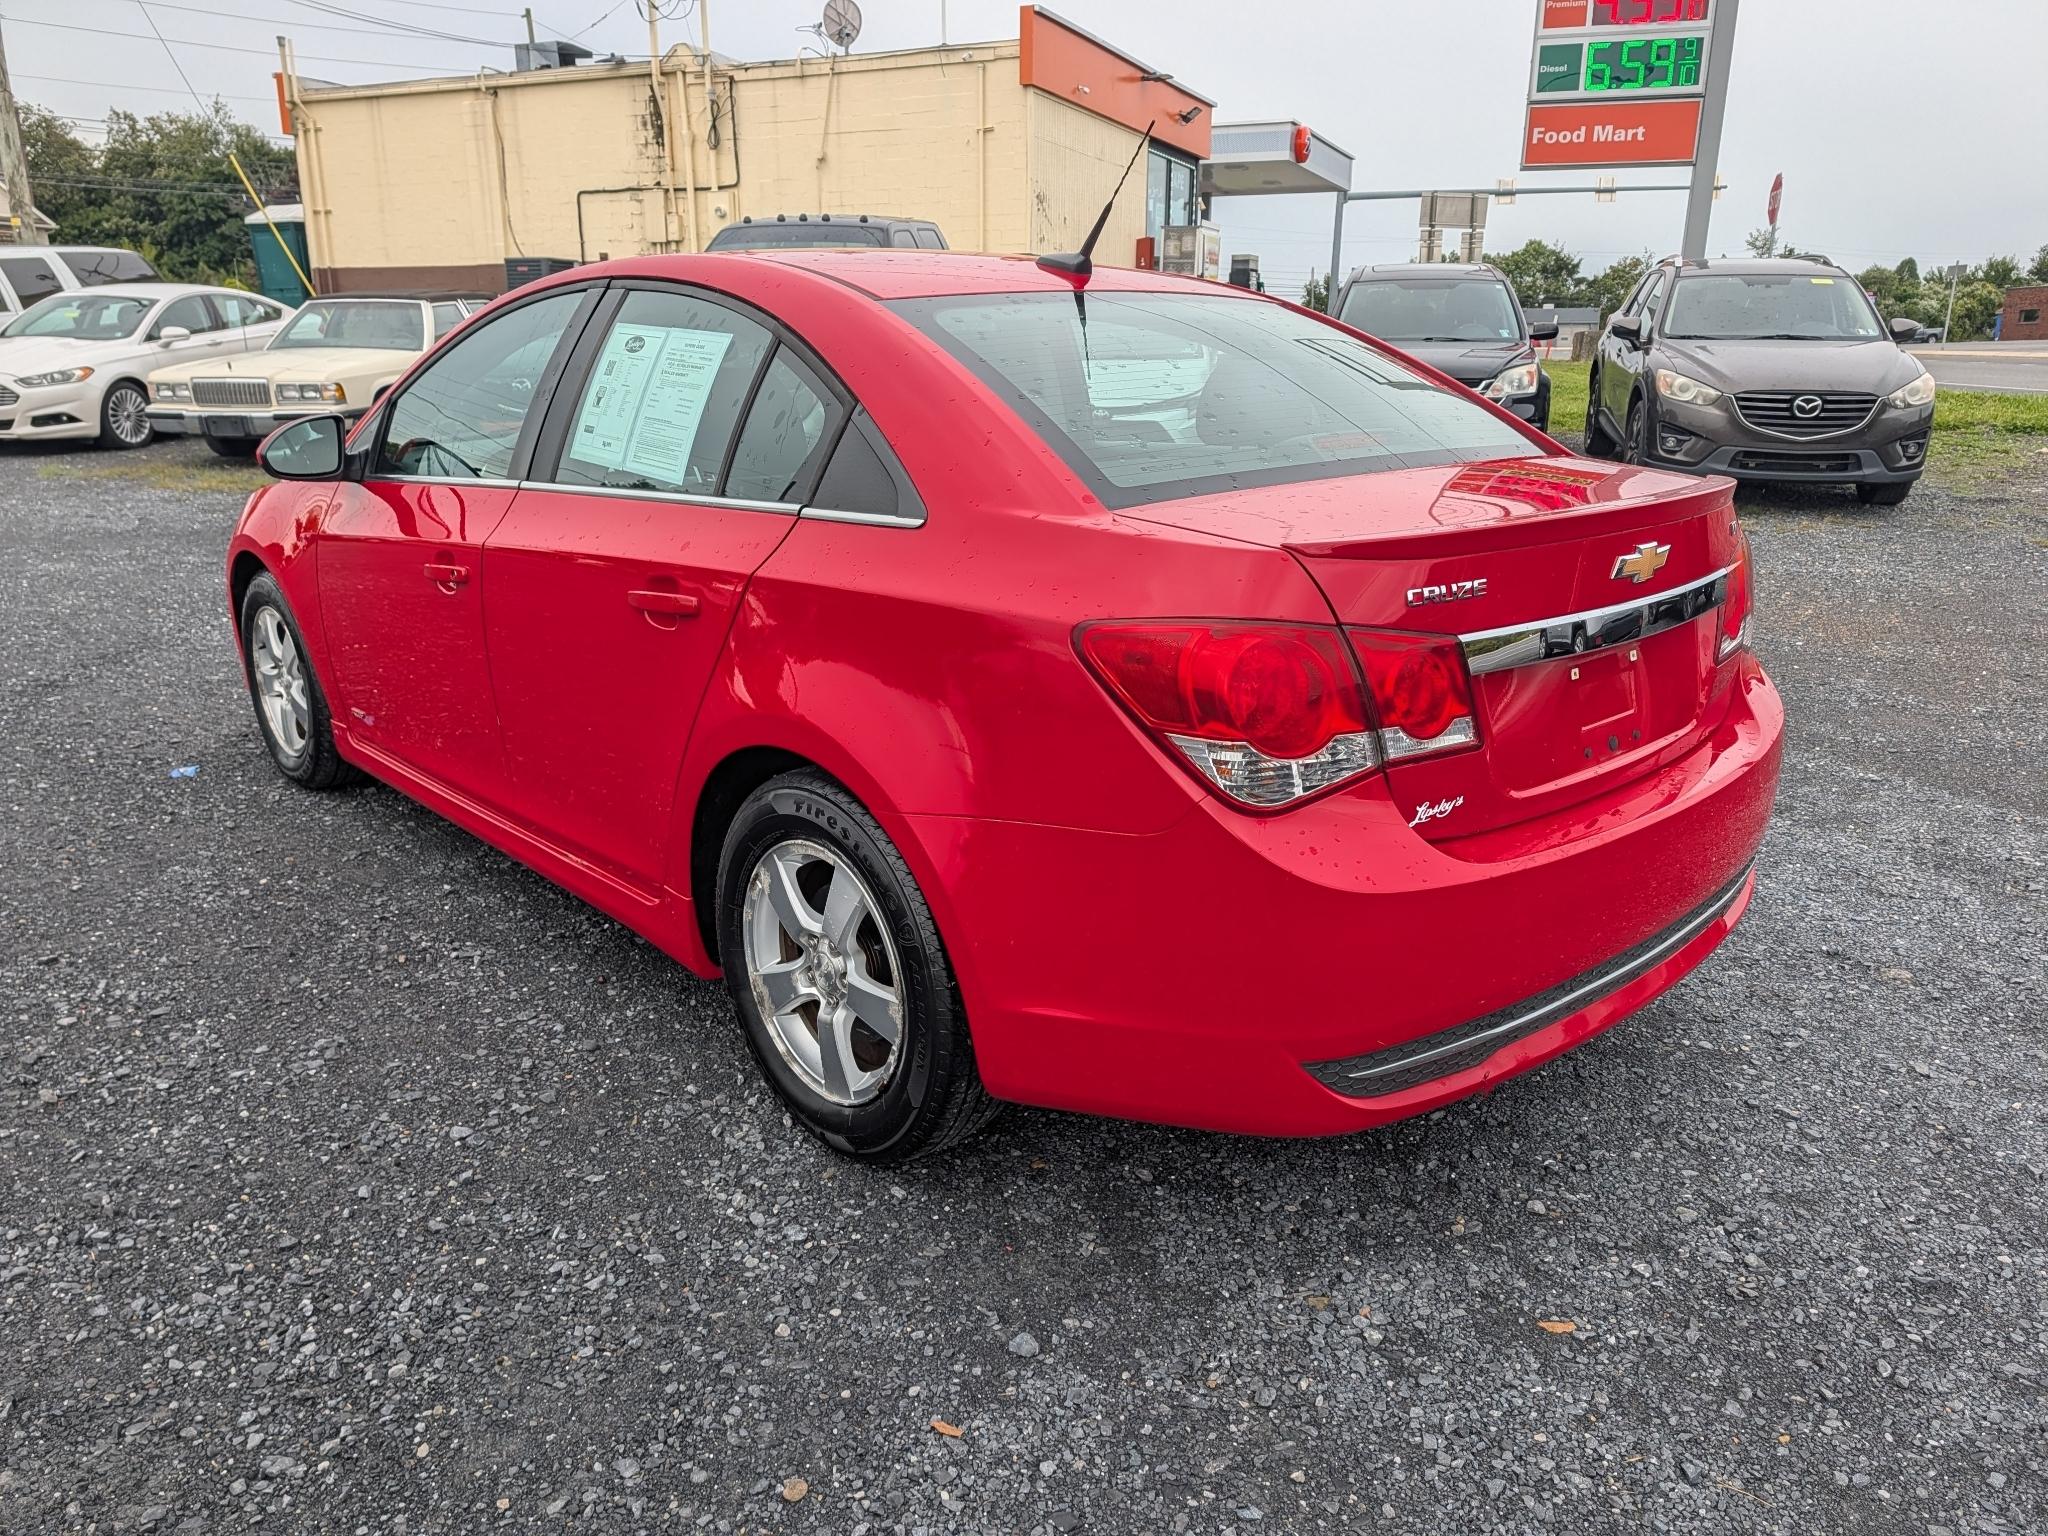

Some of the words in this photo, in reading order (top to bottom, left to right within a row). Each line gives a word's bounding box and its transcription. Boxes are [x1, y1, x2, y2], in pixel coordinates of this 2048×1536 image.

[1540, 63, 1568, 74] Diesel
[1586, 38, 1677, 91] 6.59
[1532, 125, 1587, 145] Food
[1592, 124, 1646, 143] Mart
[1406, 578, 1488, 608] CRUZE
[1408, 795, 1464, 828] Lipsky's
